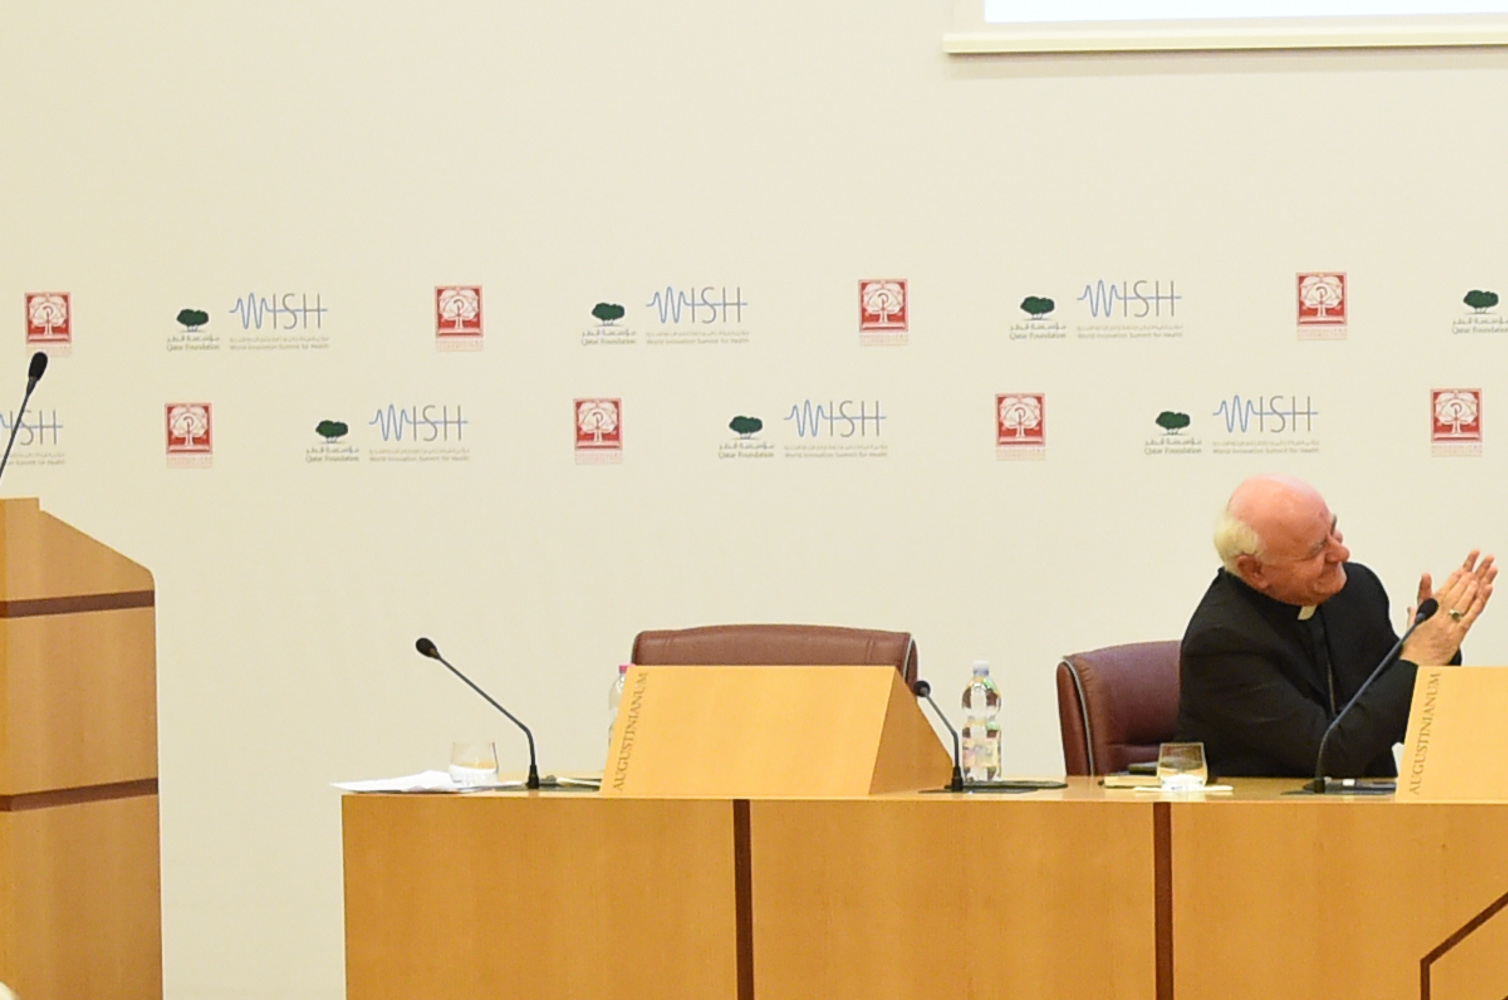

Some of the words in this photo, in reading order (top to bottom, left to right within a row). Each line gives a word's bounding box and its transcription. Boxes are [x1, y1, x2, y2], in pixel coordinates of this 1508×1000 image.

[229, 292, 327, 329] WISH
[646, 286, 748, 324] WISH
[1077, 280, 1182, 317] WISH
[0, 409, 63, 446] ISH
[369, 404, 468, 441] WISH
[784, 399, 887, 437] WISH
[1213, 395, 1318, 433] WISH
[612, 672, 648, 791] AUGUSTINIANUM
[1408, 672, 1441, 795] AUGUSTINIANUM
